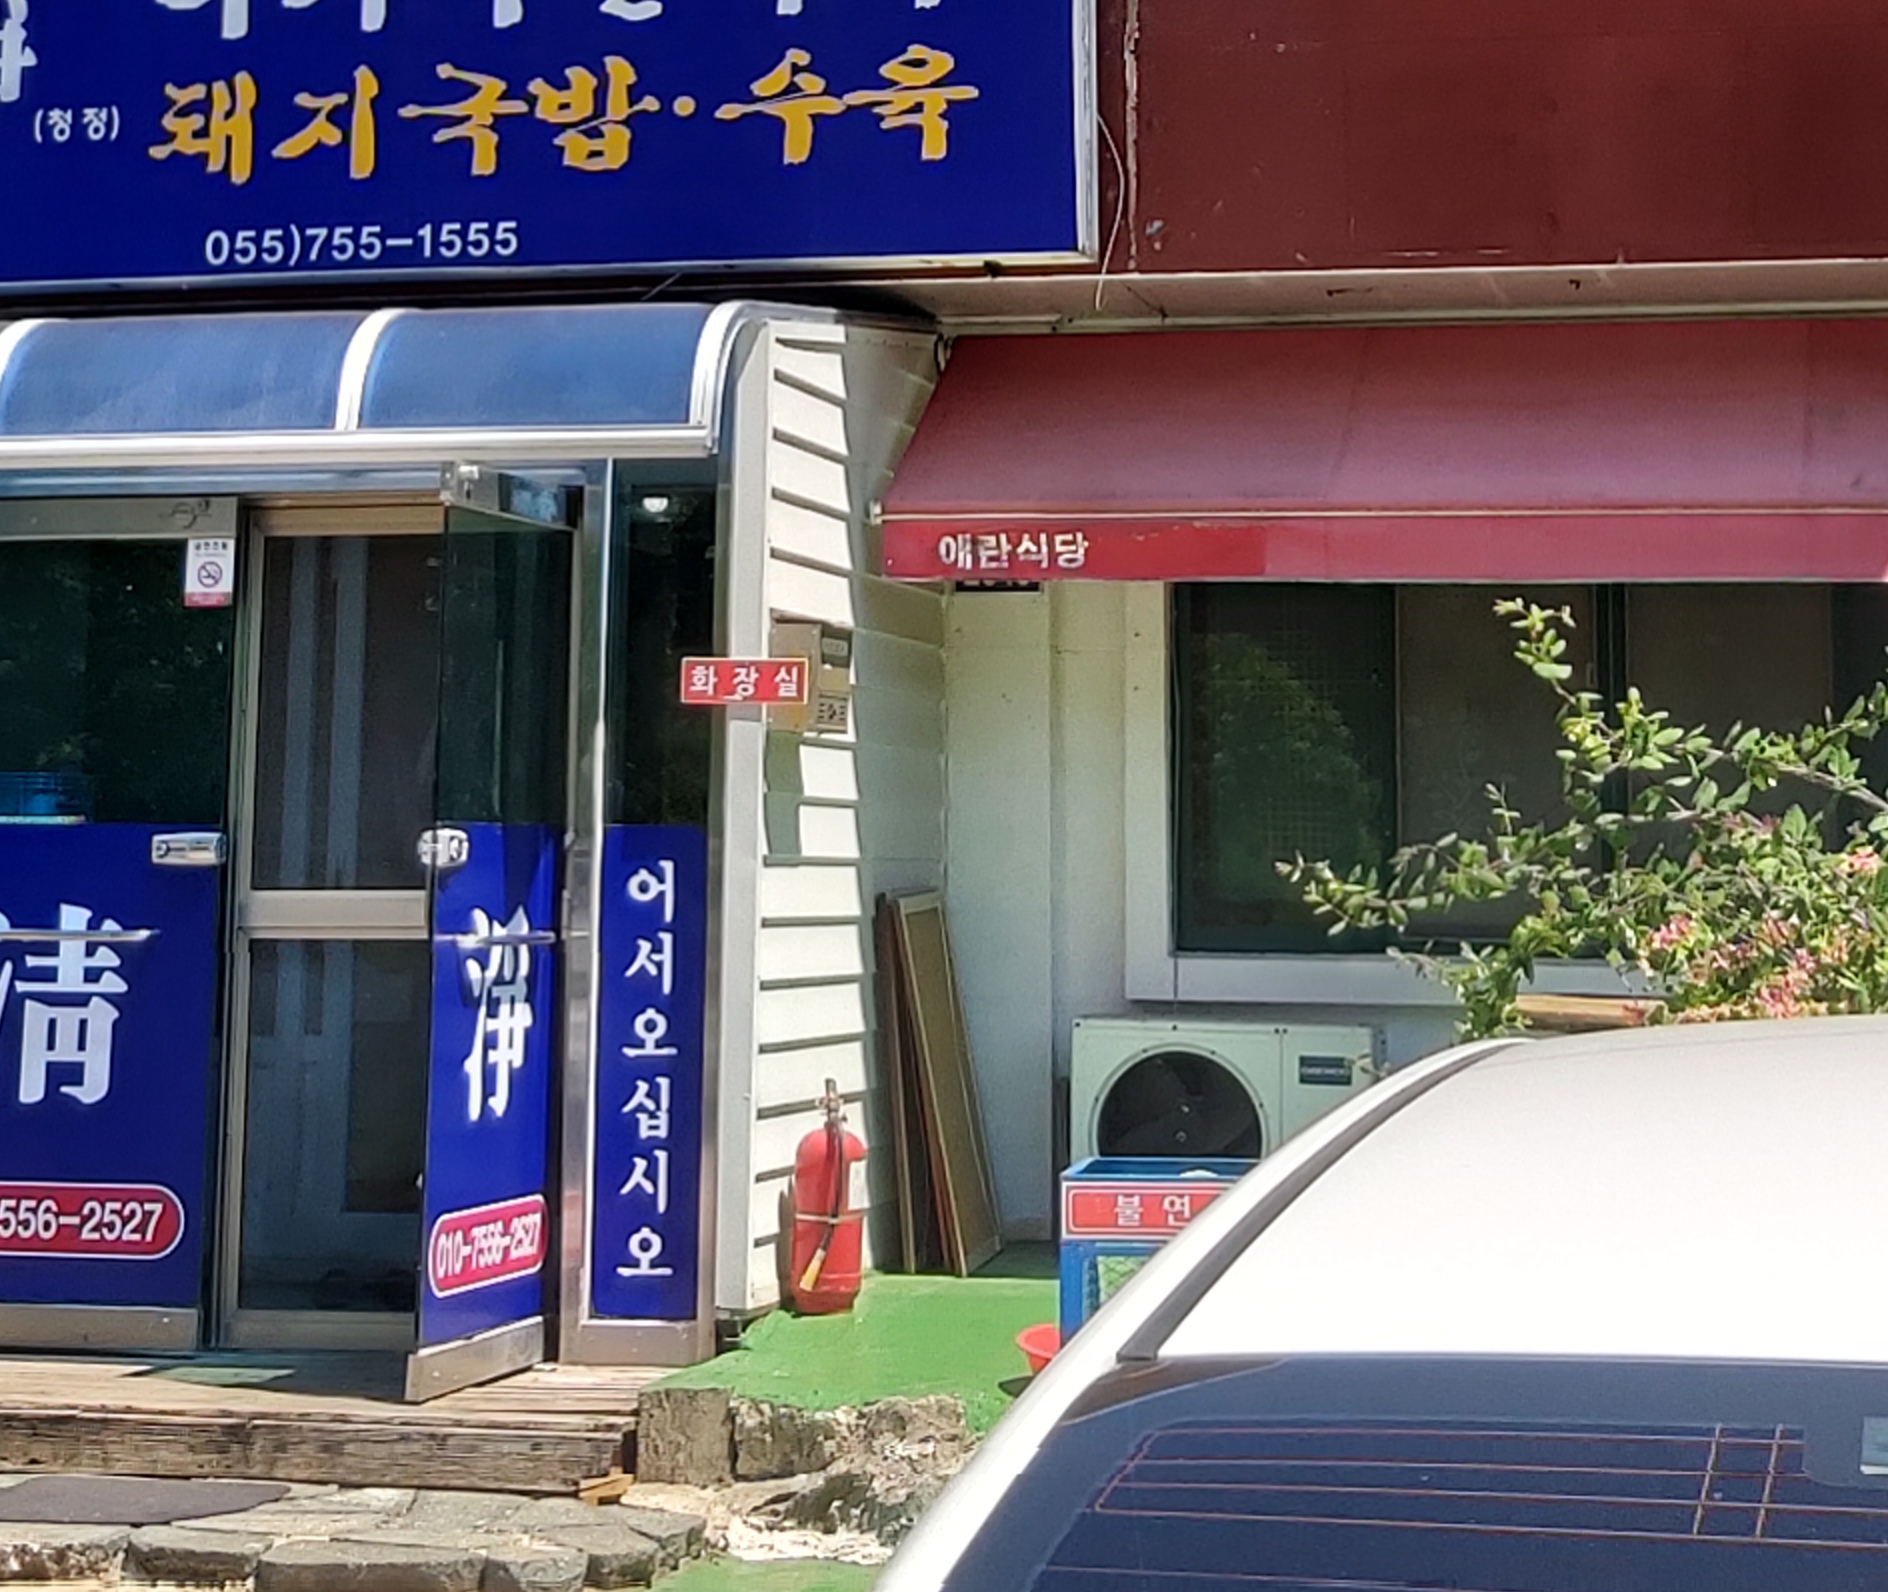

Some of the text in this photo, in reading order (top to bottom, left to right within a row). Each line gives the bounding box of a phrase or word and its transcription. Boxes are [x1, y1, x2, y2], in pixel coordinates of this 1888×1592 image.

[205, 221, 518, 267] 055)755-1555
[938, 532, 1089, 570] 애란식당
[689, 665, 799, 698] 화장실
[616, 859, 679, 1277] 어서오십시오
